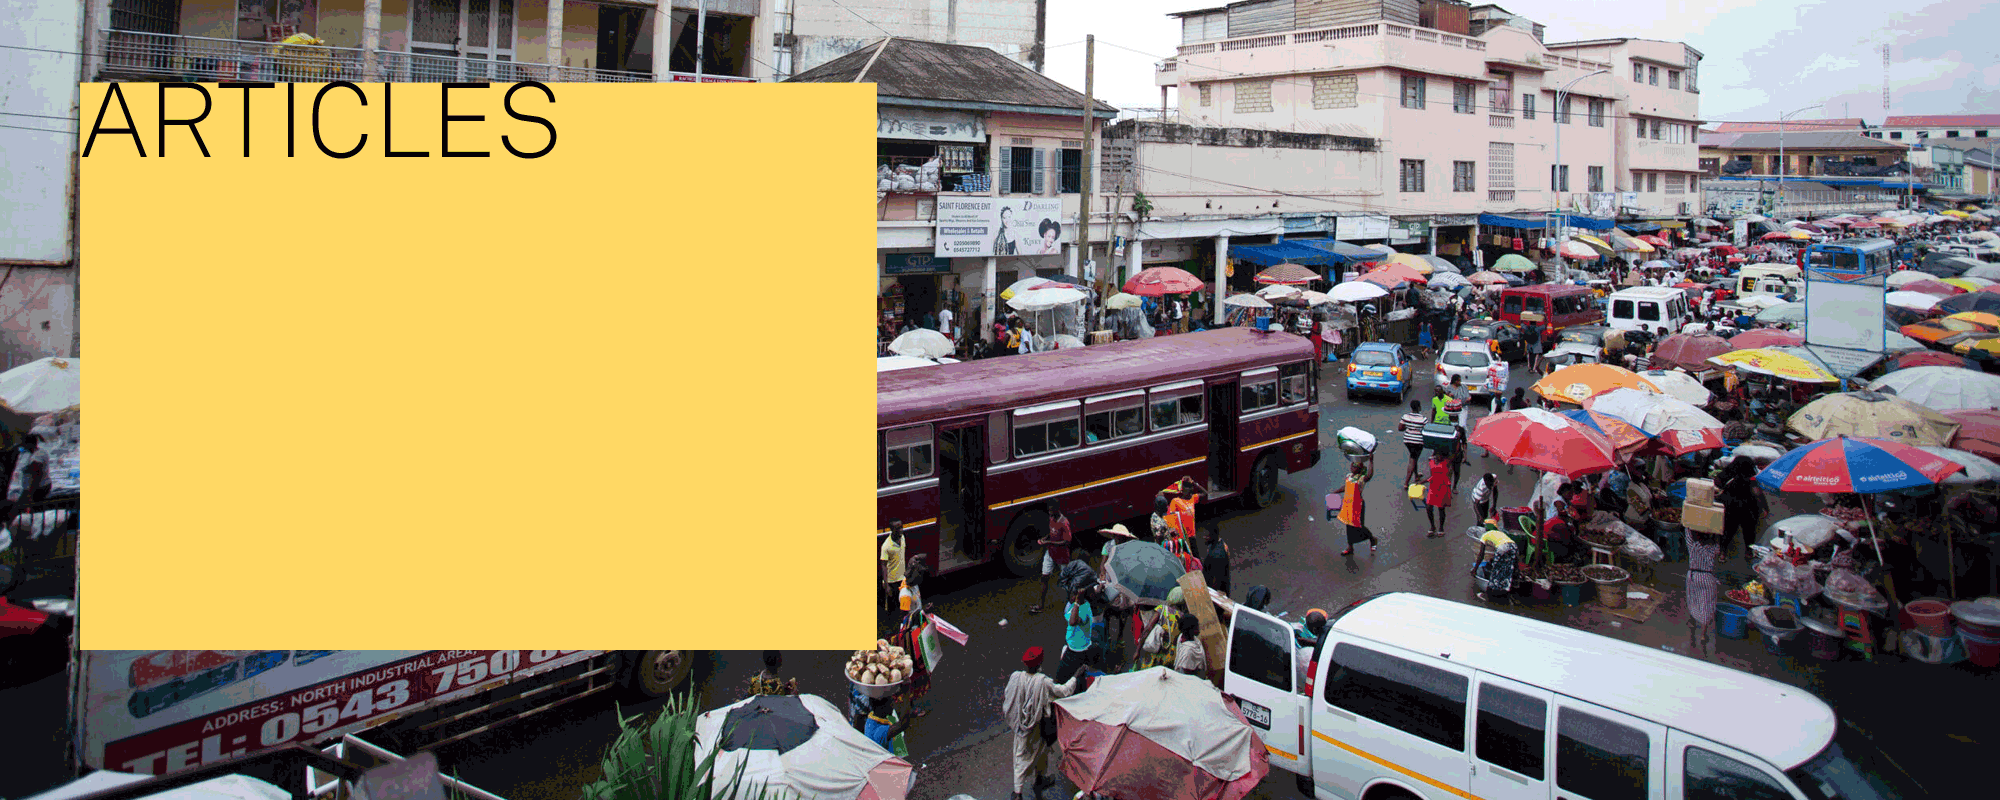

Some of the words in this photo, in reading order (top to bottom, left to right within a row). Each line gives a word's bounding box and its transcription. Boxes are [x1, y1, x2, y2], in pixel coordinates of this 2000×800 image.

[939, 202, 954, 210] SAINT
[122, 733, 247, 776] TEL:
[260, 679, 410, 746] 0543
[431, 650, 520, 694] 750
[202, 701, 285, 733] ADDRESS:
[290, 681, 346, 707] NORTH
[350, 657, 435, 689] INDUSTRIAL
